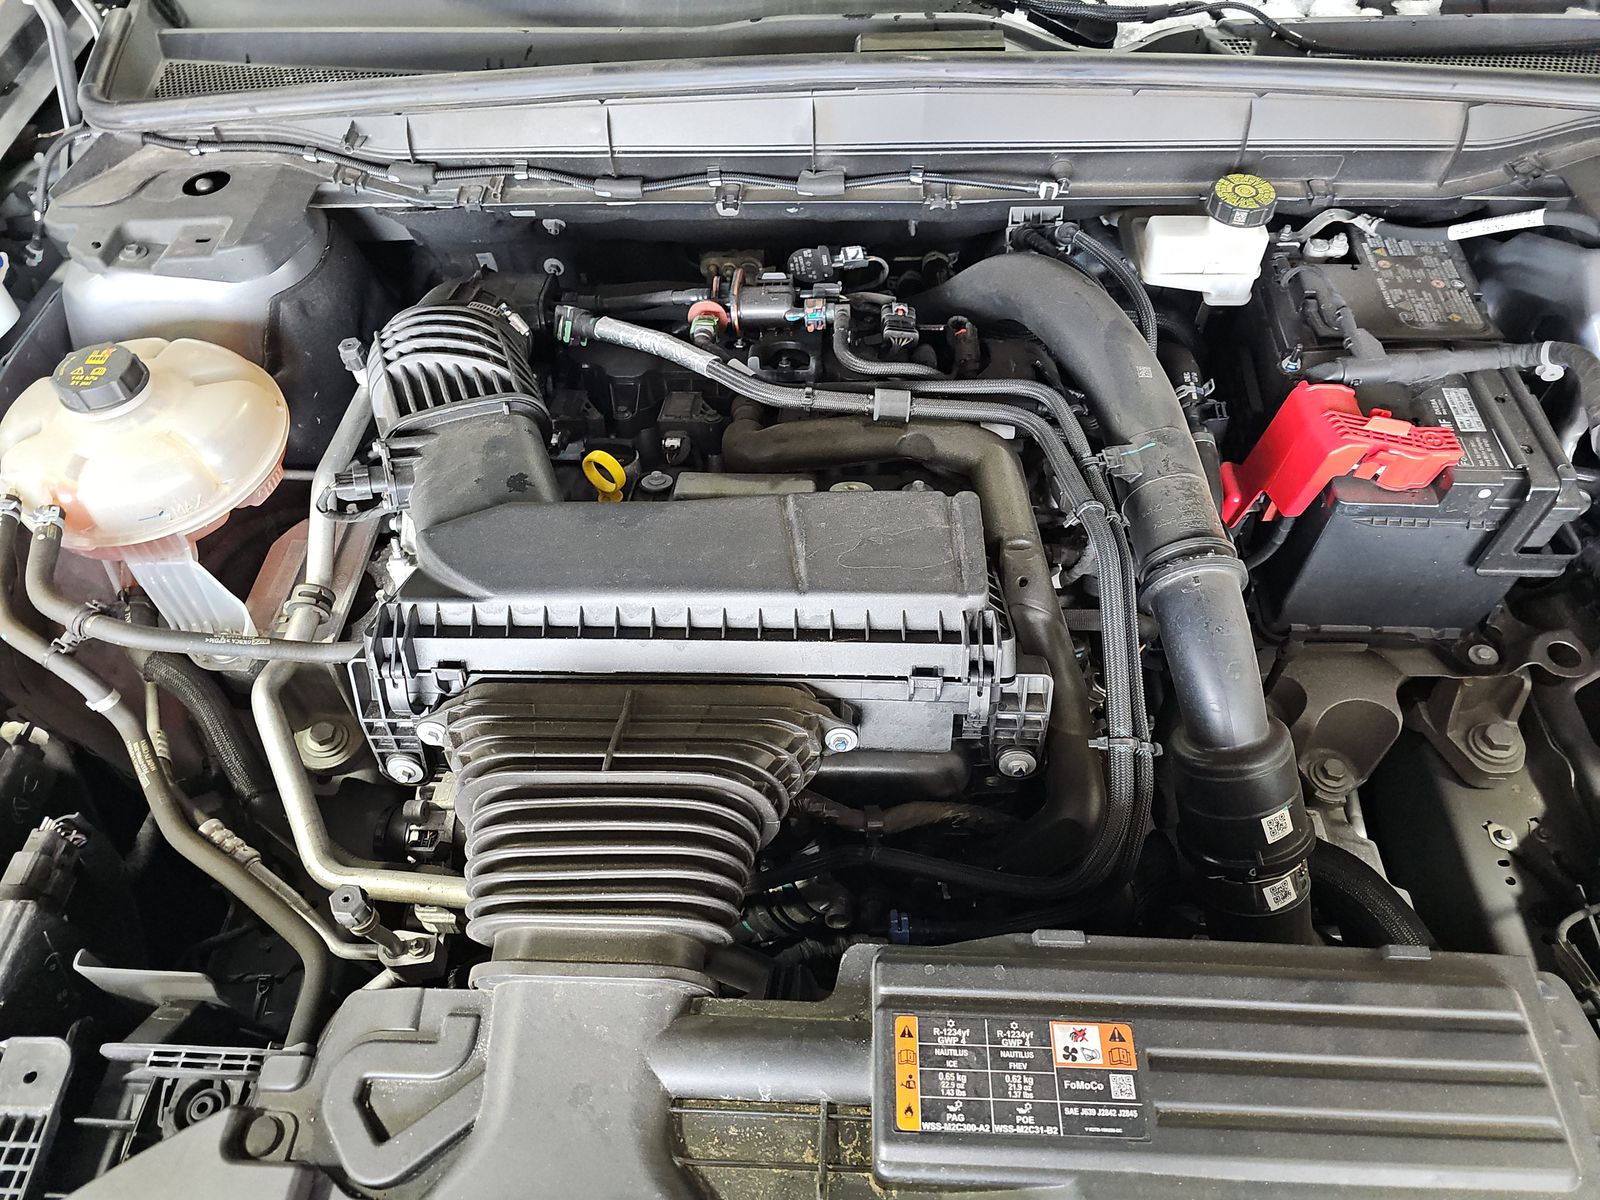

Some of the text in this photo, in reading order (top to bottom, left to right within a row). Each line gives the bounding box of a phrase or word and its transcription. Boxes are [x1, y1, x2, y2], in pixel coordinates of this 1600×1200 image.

[933, 1028, 970, 1037] R-1234yf
[997, 1030, 1034, 1039] R-1234yf
[960, 1037, 967, 1045] 4
[1001, 1039, 1023, 1047] GWP
[935, 1048, 968, 1056] NAUTILUS
[1000, 1051, 1034, 1059] NAUTILUS
[1008, 1062, 1028, 1070] FHEV
[938, 1072, 967, 1083] 0.65 kg
[1004, 1075, 1034, 1085] 0.62 kg
[1063, 1080, 1104, 1091] FoMoCo
[1023, 1091, 1034, 1099] lbs
[1064, 1107, 1079, 1115] SAE
[1015, 1116, 1035, 1124] POE
[922, 1122, 990, 1132] WSS-M2C300-A2
[994, 1125, 1058, 1135] WSS-M2C31-B2
